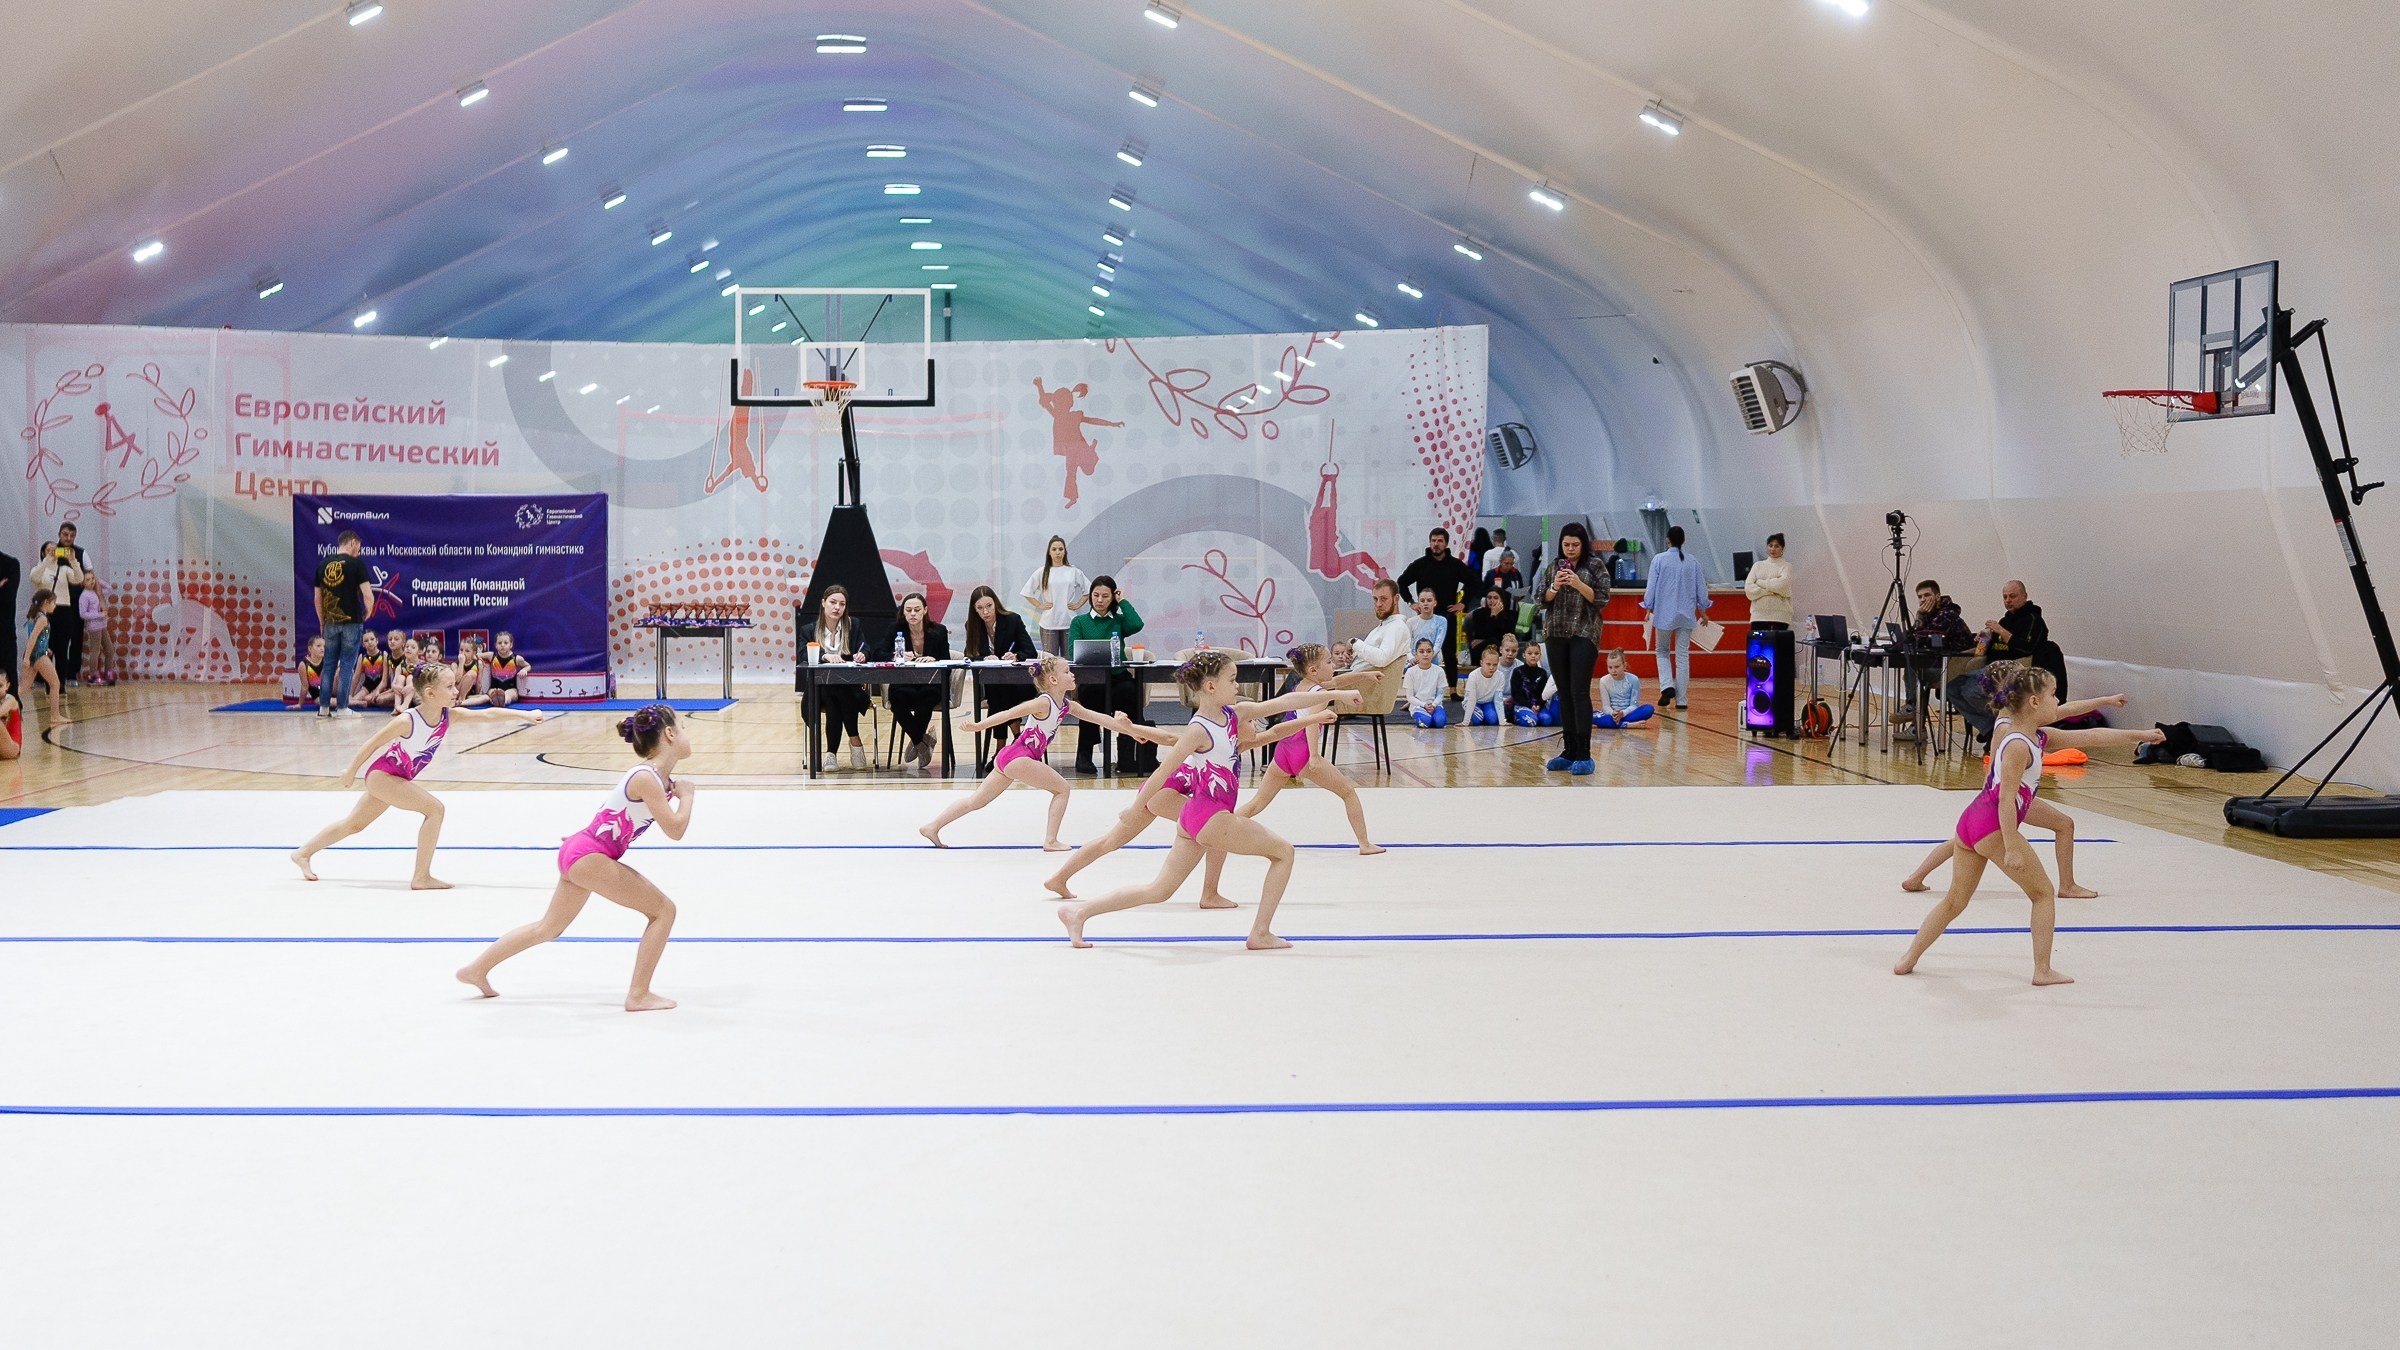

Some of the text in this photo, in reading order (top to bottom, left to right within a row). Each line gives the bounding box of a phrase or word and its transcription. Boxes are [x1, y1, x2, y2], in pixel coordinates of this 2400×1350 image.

[234, 393, 446, 425] Европейский
[234, 432, 500, 466] Гимнастический
[379, 546, 385, 555] и
[387, 544, 437, 556] Московской
[438, 544, 472, 556] области
[474, 546, 485, 556] по
[486, 544, 533, 557] Командной
[535, 545, 584, 555] гимнастике
[411, 577, 526, 594] Федерация Командной
[411, 594, 509, 607] Гимнастики России
[551, 679, 563, 695] 3
